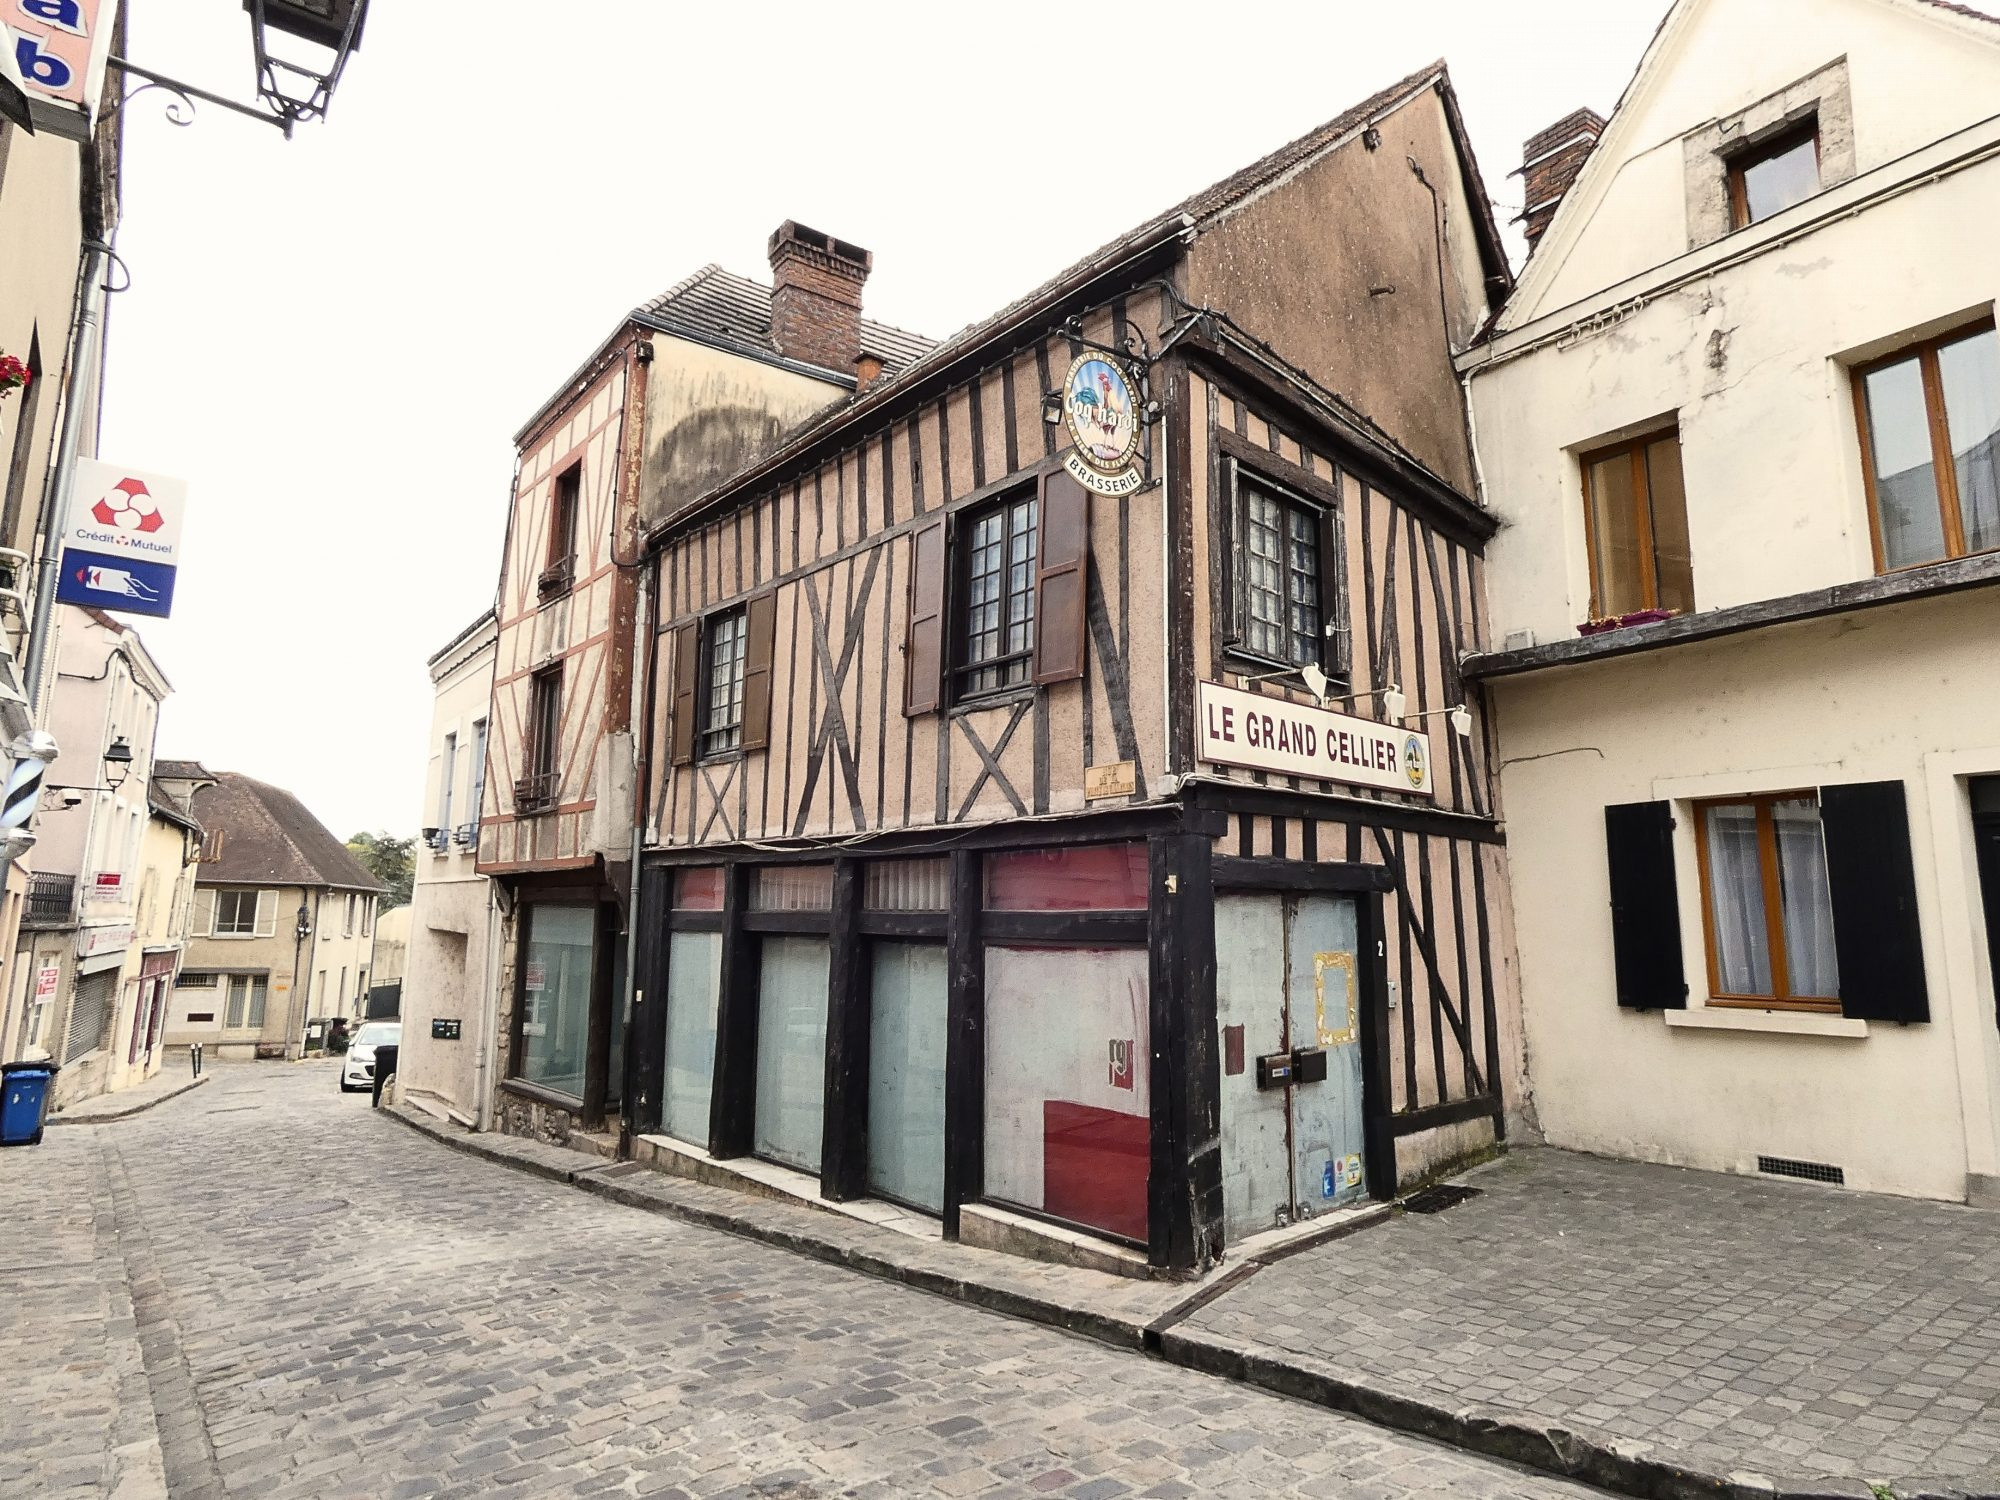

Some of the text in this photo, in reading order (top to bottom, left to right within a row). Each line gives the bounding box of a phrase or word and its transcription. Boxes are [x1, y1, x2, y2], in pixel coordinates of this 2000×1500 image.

[1065, 352, 1091, 388] BRASSERIE
[1093, 351, 1104, 361] DU
[1106, 358, 1123, 376] COQ
[1069, 458, 1138, 492] BRASSERIE
[76, 529, 172, 554] Crédit Mutuel
[1208, 703, 1397, 773] LE GRAND CELLIER
[1377, 940, 1383, 957] 2
